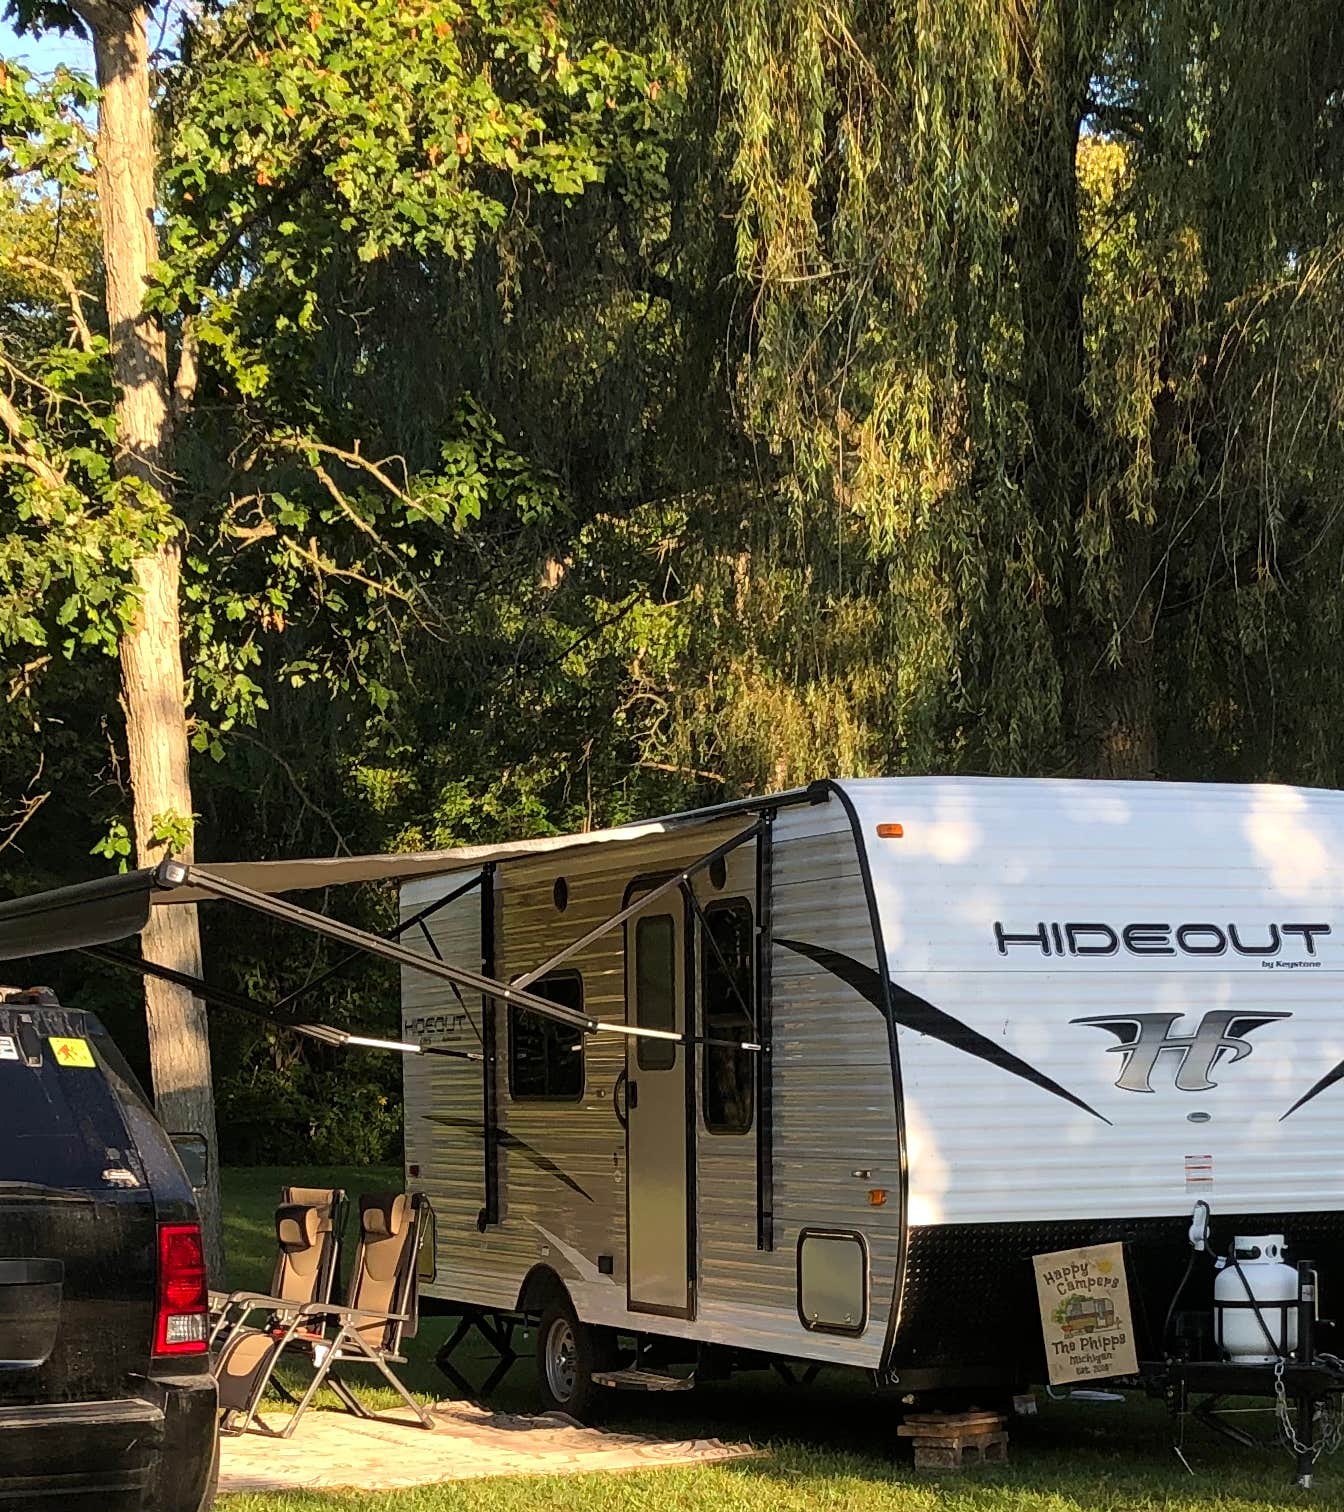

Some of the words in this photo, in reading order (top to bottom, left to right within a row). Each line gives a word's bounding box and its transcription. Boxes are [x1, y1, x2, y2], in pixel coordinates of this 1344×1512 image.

[993, 921, 1331, 956] HIDEOUT
[1261, 960, 1274, 969] by
[405, 1014, 466, 1035] HIDEOUT
[1043, 1261, 1088, 1285] Happy
[1056, 1276, 1120, 1295] Campers
[1051, 1340, 1076, 1355] The
[1080, 1333, 1126, 1352] Phipps
[1069, 1352, 1112, 1365] Michigan
